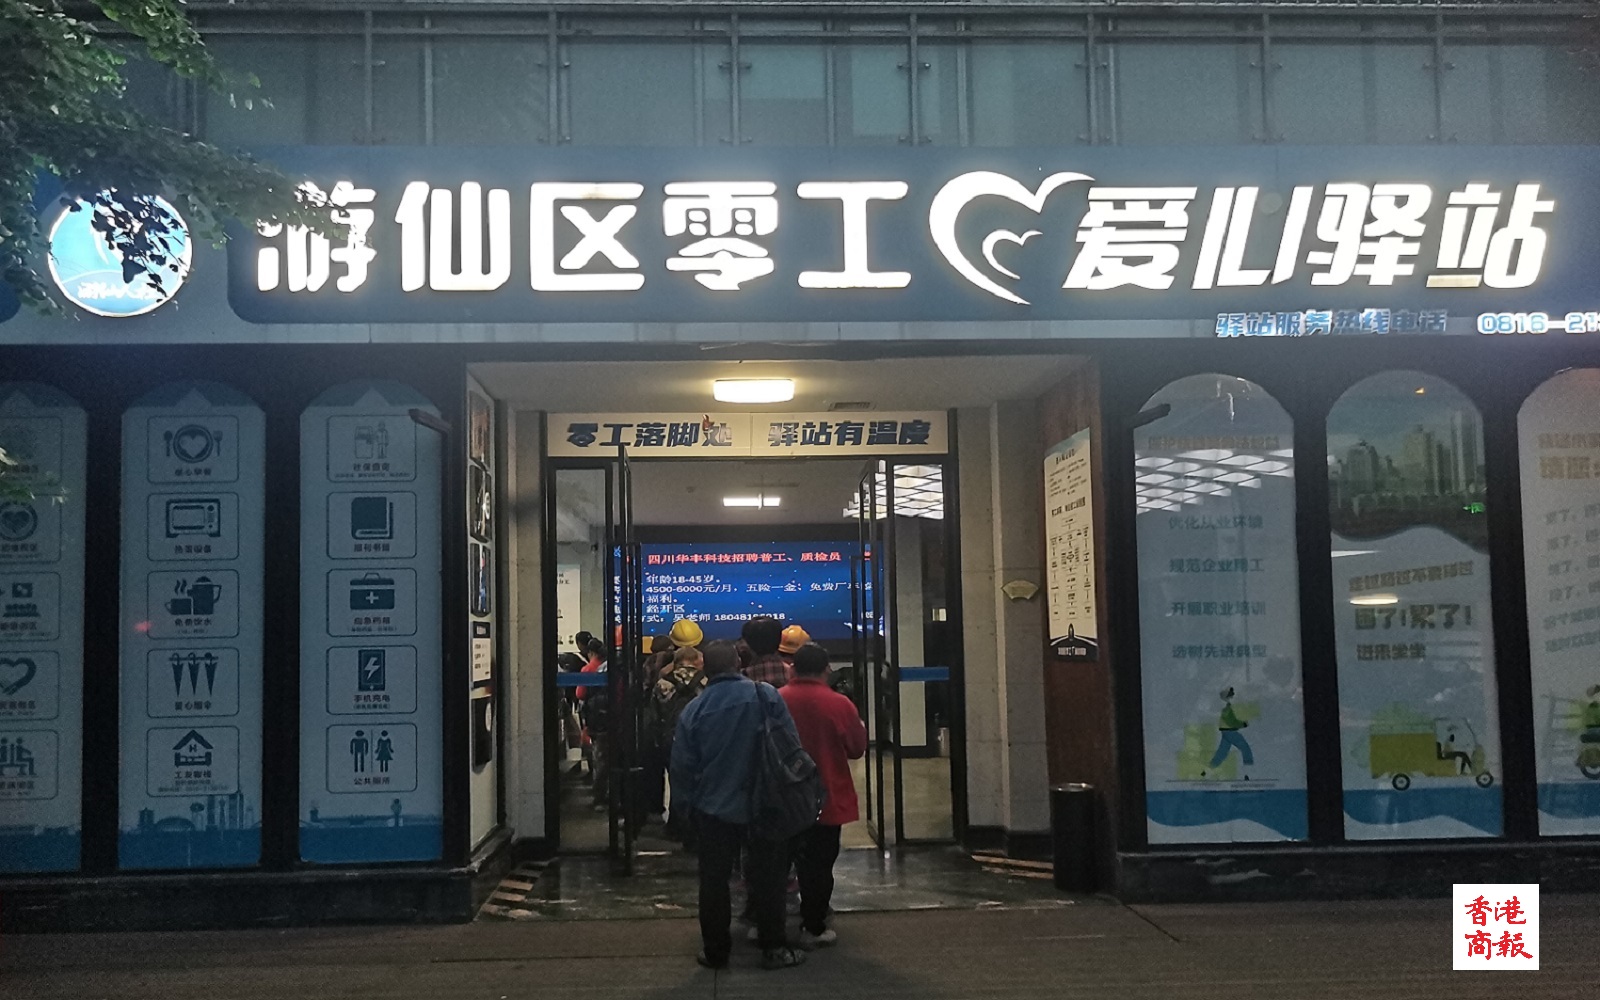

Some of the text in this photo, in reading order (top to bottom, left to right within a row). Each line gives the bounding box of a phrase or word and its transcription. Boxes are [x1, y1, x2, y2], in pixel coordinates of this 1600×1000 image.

[256, 181, 1555, 292] 游仙区零工 爱心驿站
[1216, 308, 1448, 338] 驿站服务热线电话
[566, 419, 931, 448] 零工落脚处 驿站有温度
[1169, 558, 1265, 573] 规范企业用工
[353, 694, 391, 703] 手机充电
[353, 776, 391, 786] 公共厕所
